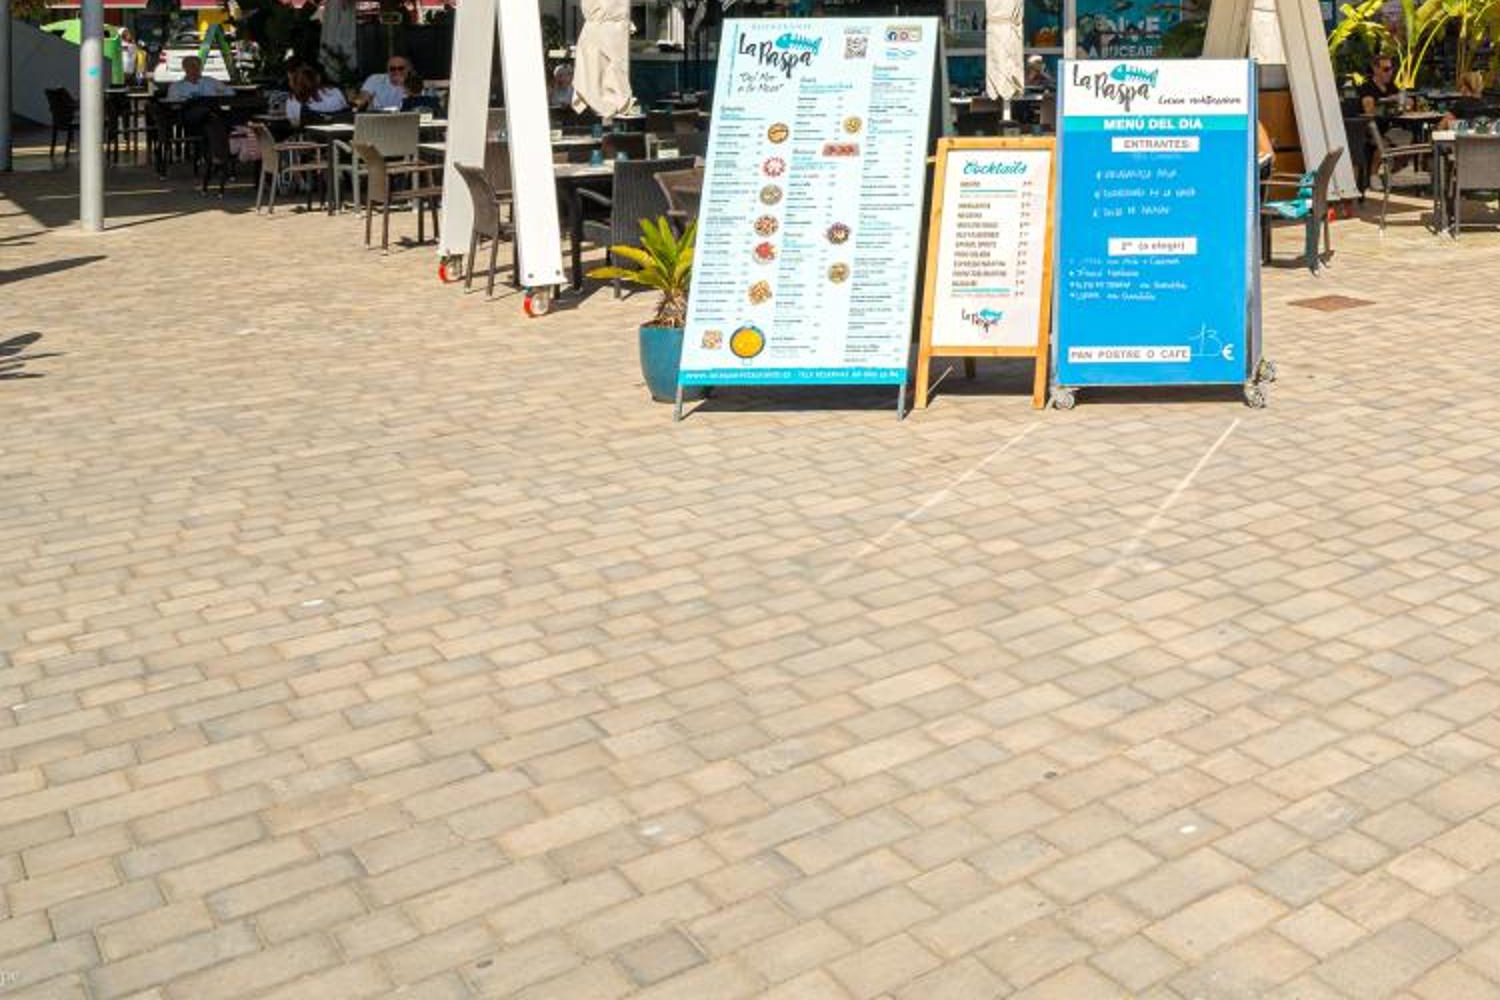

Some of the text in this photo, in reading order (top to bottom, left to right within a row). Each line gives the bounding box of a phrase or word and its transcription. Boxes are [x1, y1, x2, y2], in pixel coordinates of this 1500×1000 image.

[738, 32, 756, 57] La
[758, 41, 813, 79] Raspa
[1073, 63, 1150, 113] La Raspa
[1149, 119, 1175, 130] DEL
[1123, 139, 1190, 149] ENTRANTES
[962, 159, 1028, 175] Cocktails
[1071, 349, 1093, 360] PAN
[1097, 349, 1140, 359] POSTRE
